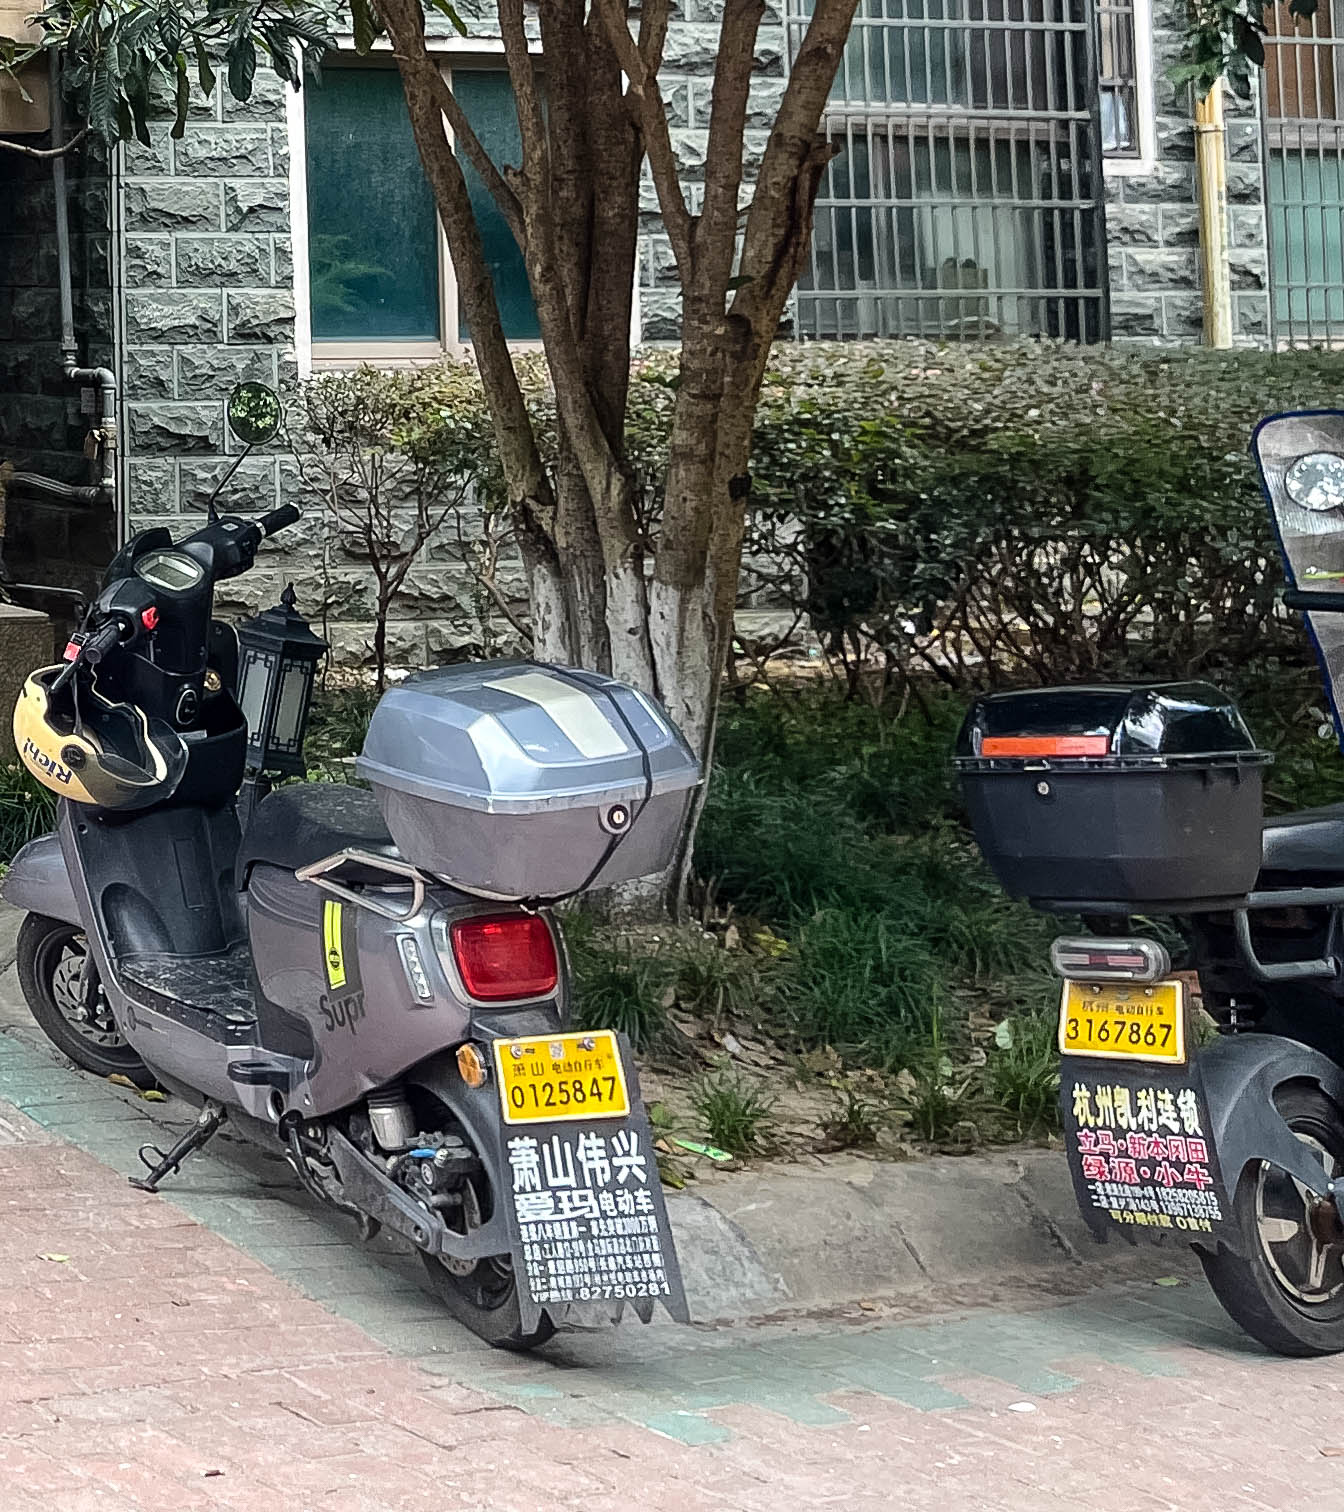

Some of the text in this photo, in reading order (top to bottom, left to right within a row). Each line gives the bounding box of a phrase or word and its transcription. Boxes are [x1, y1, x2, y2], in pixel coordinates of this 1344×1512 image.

[23, 737, 74, 785] Rich!
[1066, 1018, 1172, 1047] 3167867
[511, 1076, 616, 1109] 0125847
[1072, 1081, 1203, 1137] 杭州凯利连锁
[507, 1129, 648, 1193] 萧山伟兴
